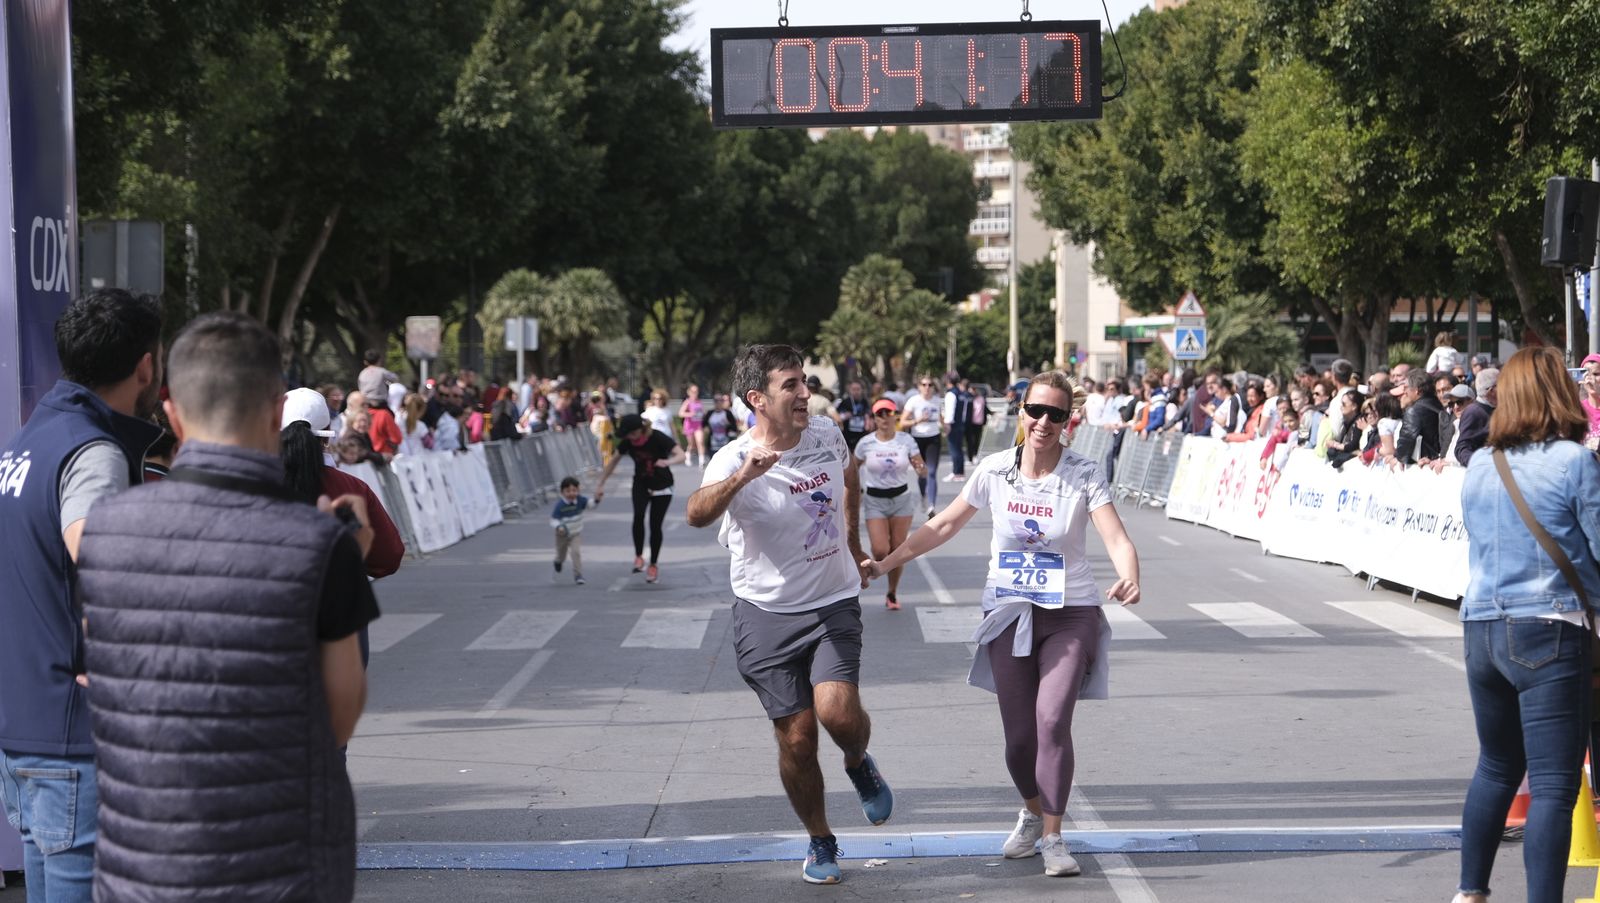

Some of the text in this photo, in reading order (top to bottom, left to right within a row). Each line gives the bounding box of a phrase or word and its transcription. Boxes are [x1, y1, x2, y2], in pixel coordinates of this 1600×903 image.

[775, 32, 1082, 114] 00:41:17
[789, 472, 830, 495] MUJER
[1007, 501, 1053, 518] MUJER
[1012, 569, 1048, 585] 276
